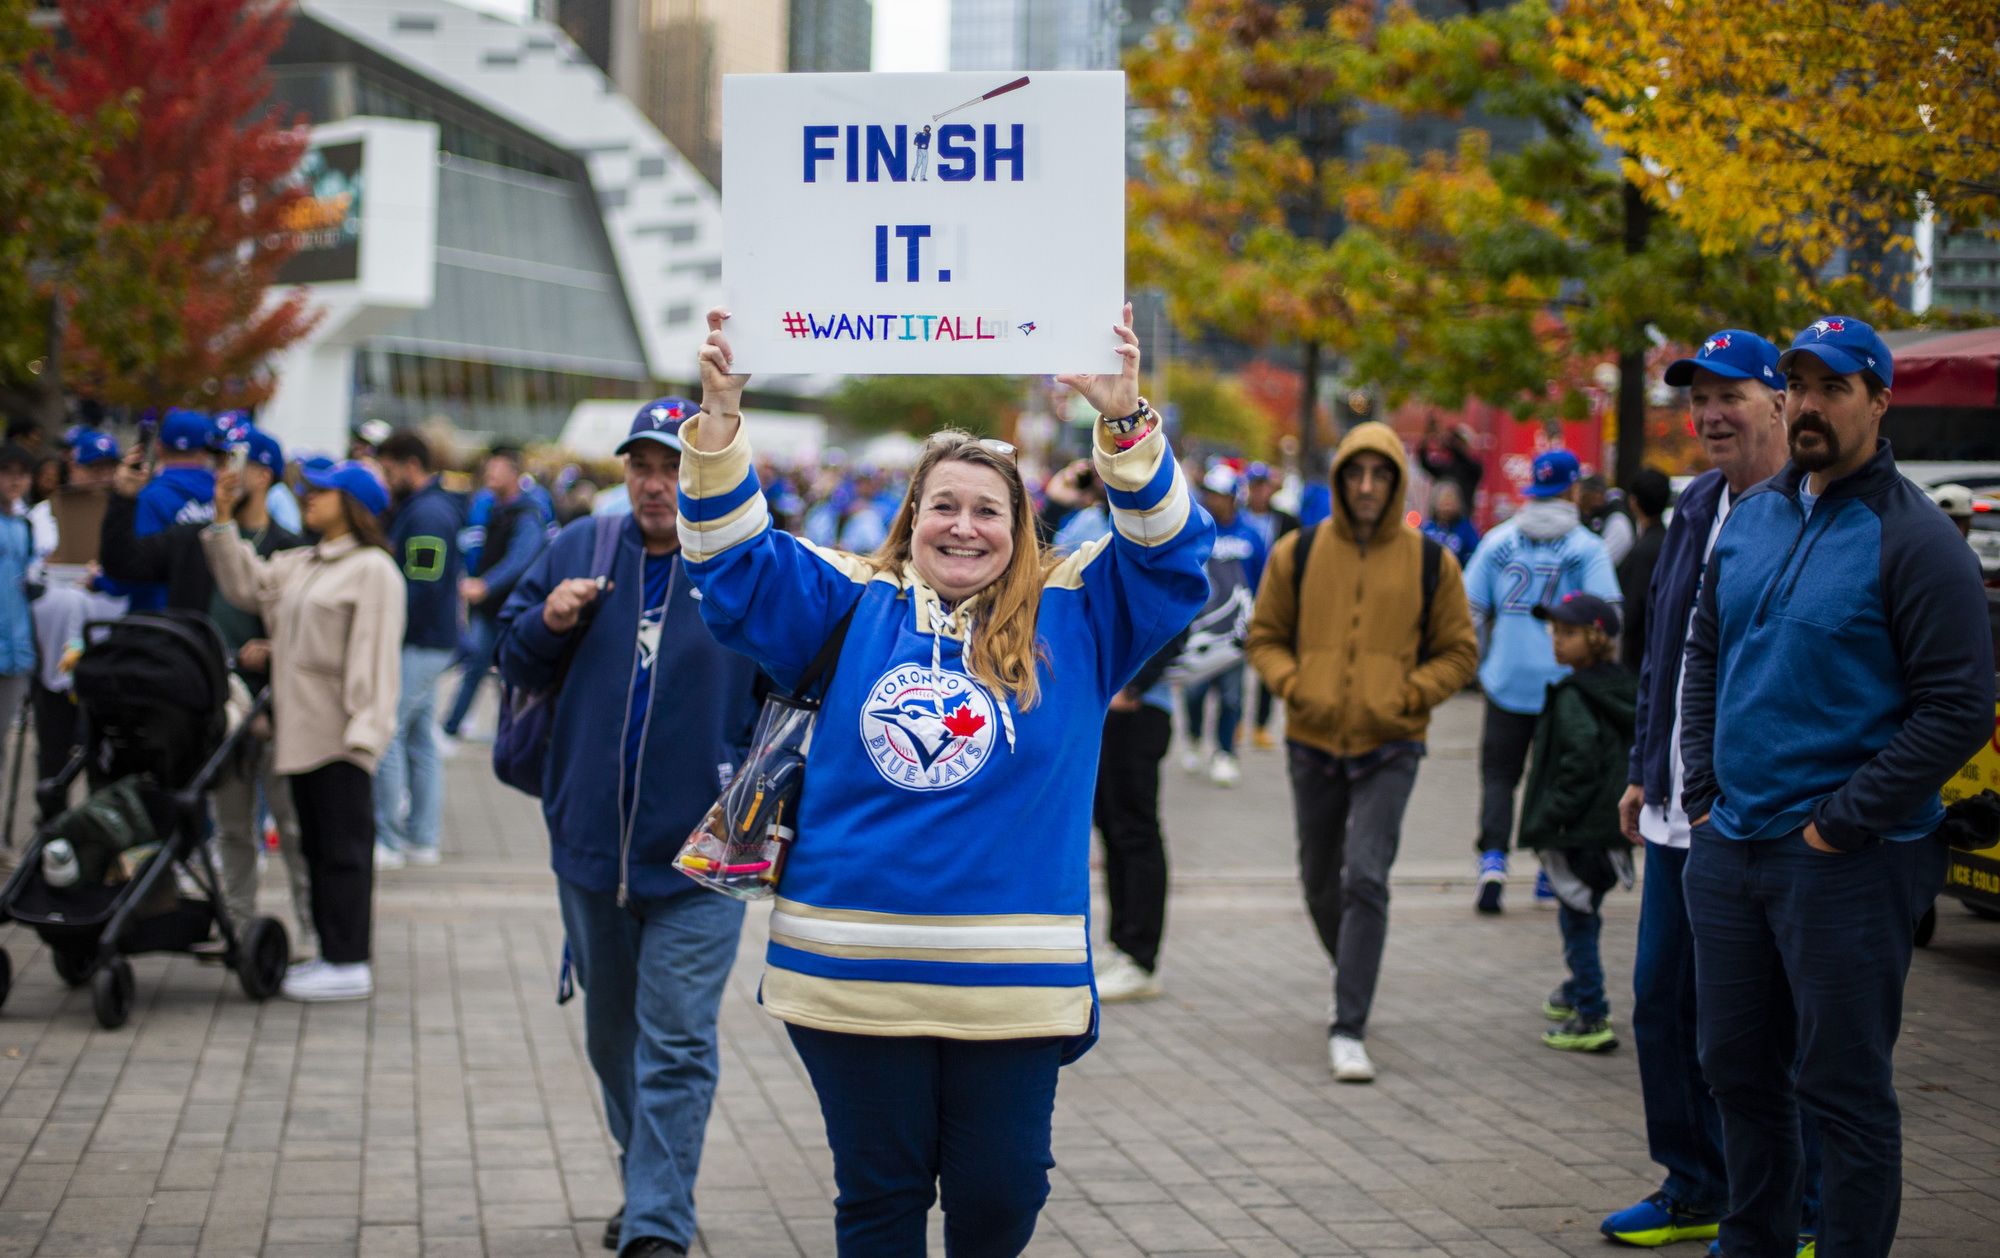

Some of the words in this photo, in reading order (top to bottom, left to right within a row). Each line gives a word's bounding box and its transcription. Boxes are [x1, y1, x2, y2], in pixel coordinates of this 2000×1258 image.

[875, 225, 951, 282] IT.
[782, 311, 995, 341] #WANTITALL
[1503, 562, 1560, 614] 27
[876, 671, 959, 704] TORONTO
[870, 734, 918, 783] BLUE
[929, 743, 982, 784] JAYS
